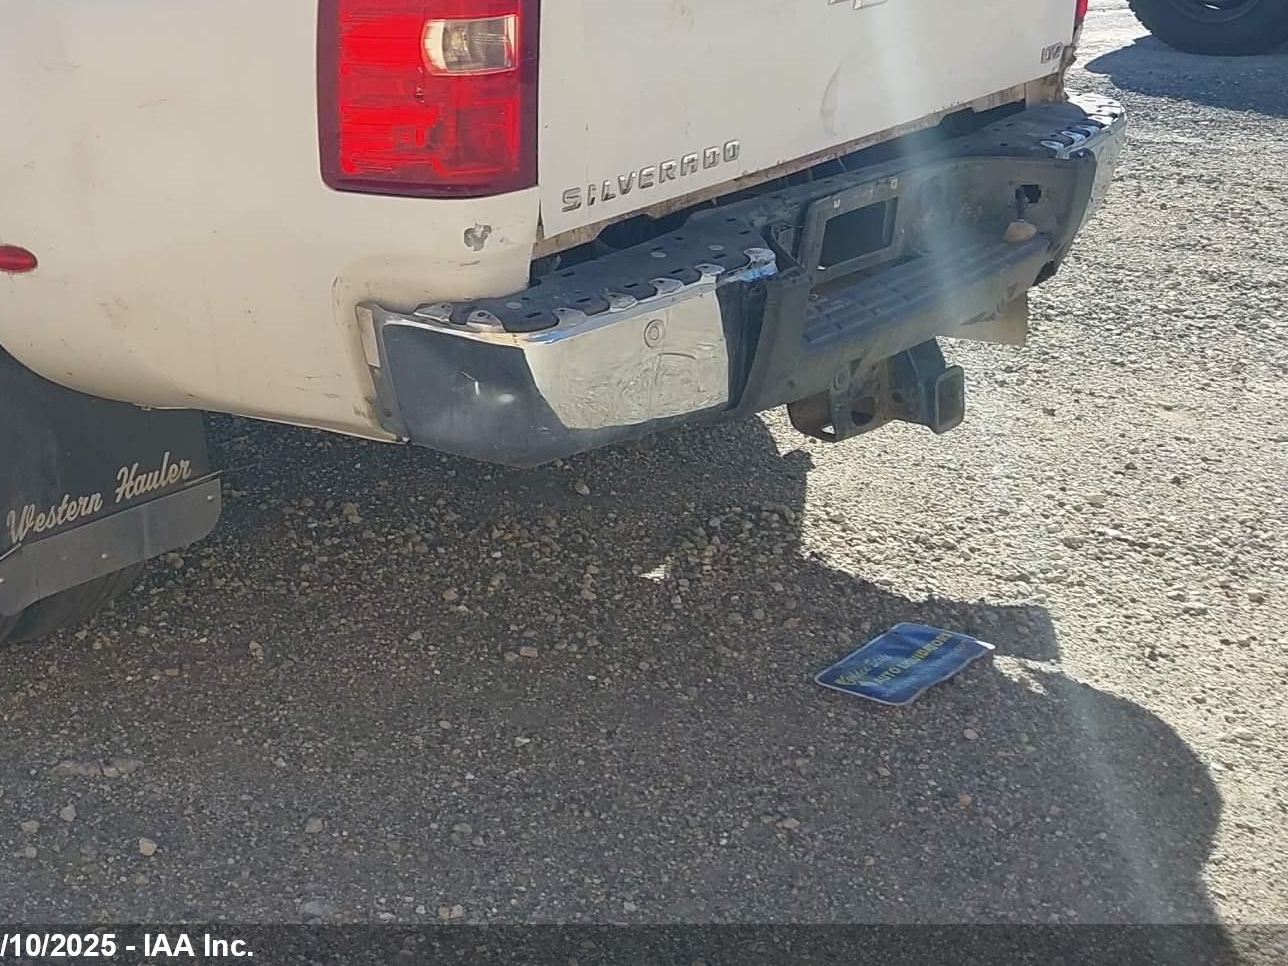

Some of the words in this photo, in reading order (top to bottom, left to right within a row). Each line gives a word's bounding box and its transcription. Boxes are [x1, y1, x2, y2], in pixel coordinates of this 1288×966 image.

[561, 139, 741, 213] SILVERADO
[6, 491, 103, 544] Western
[115, 451, 192, 503] Hauler
